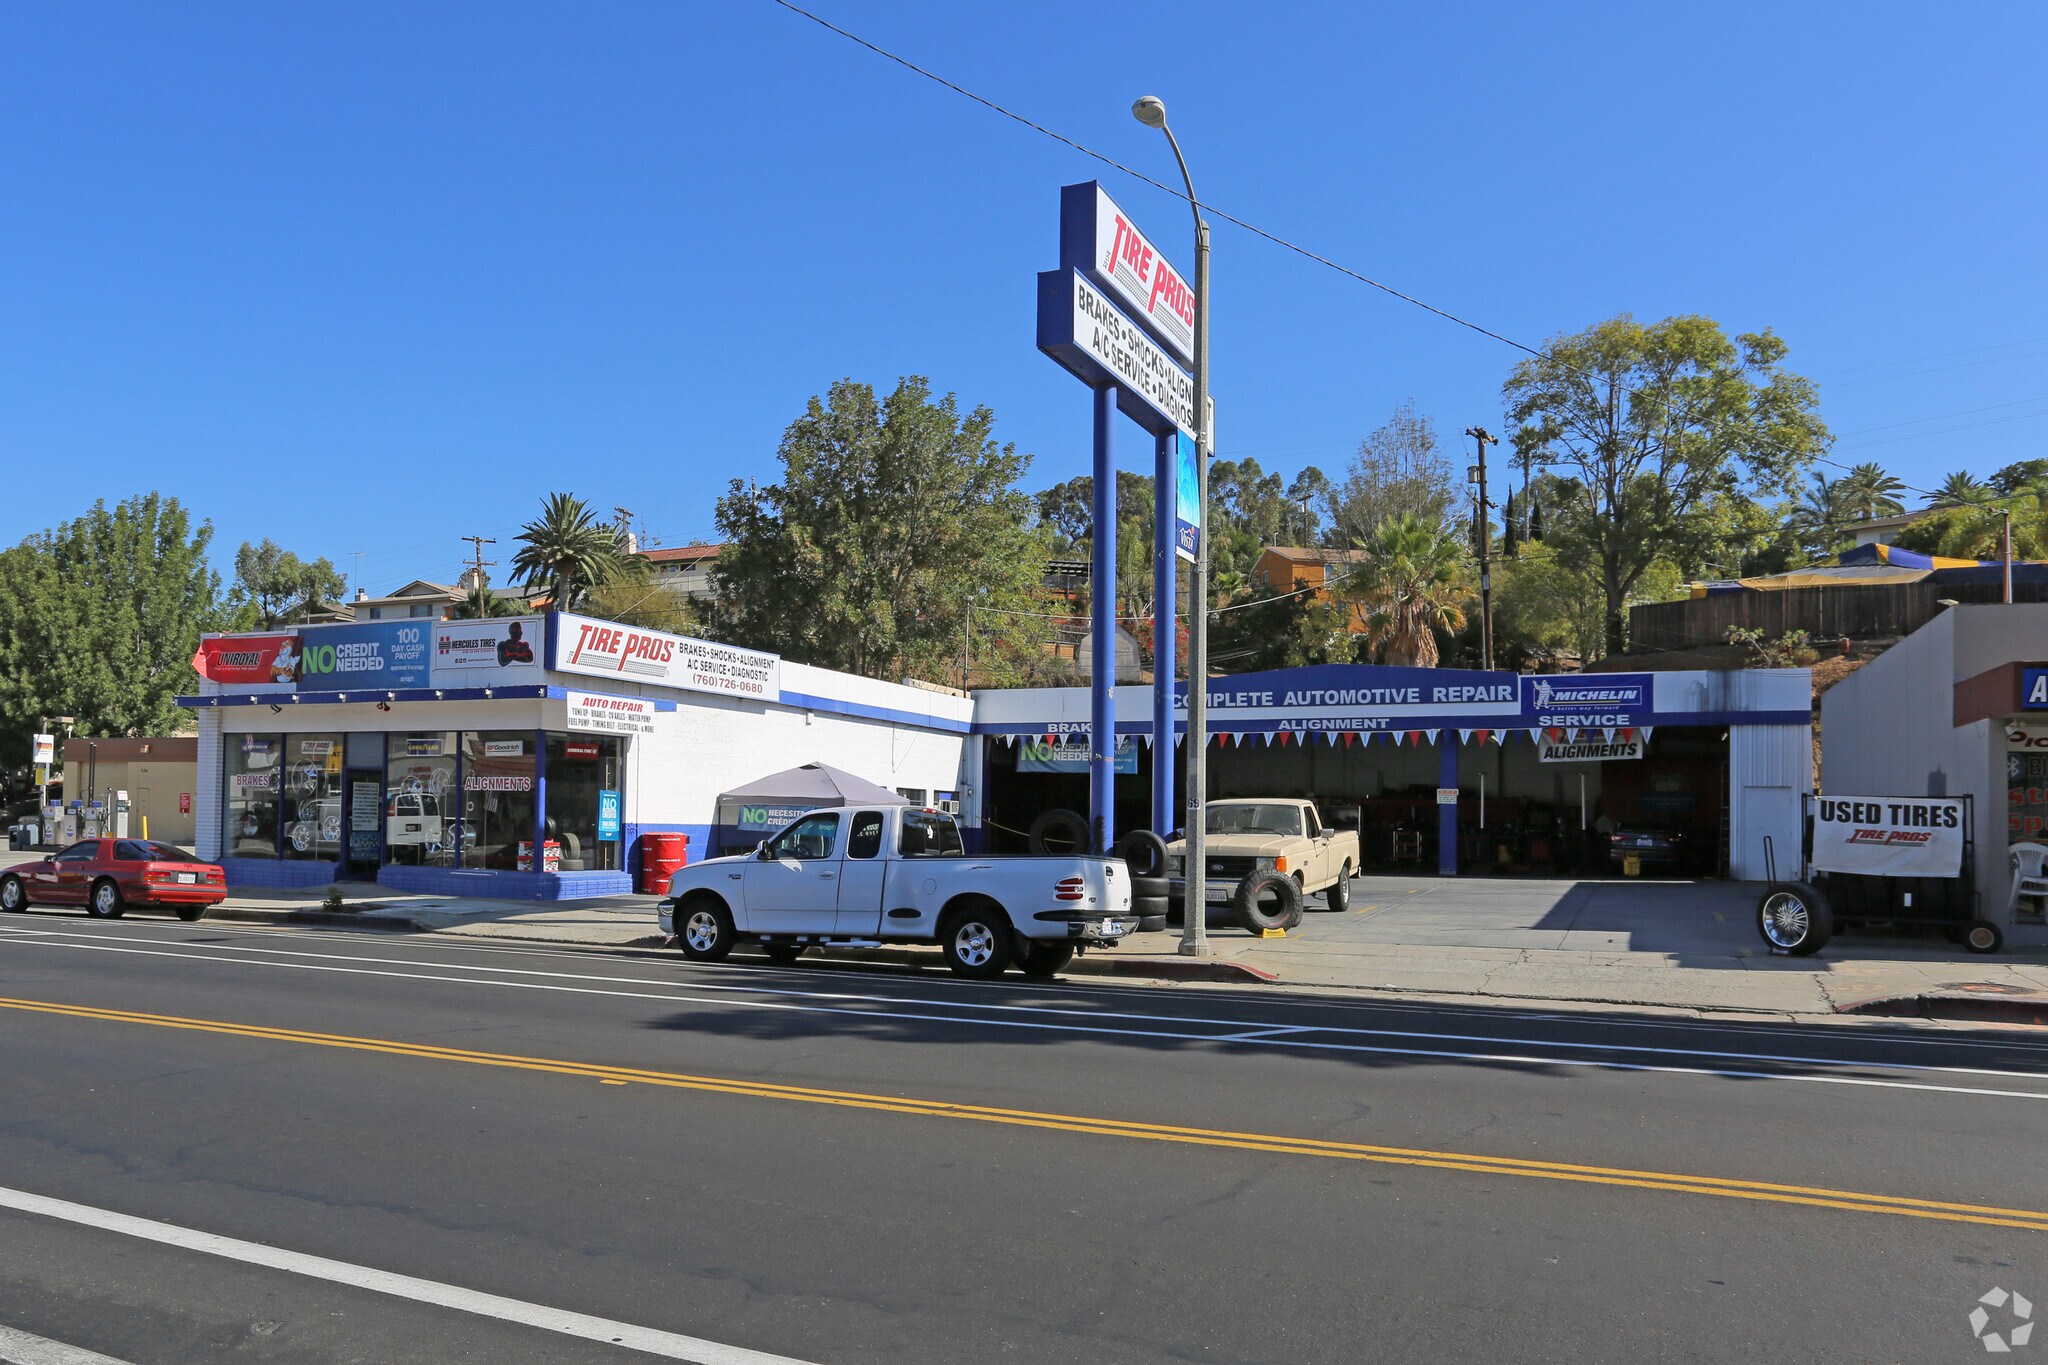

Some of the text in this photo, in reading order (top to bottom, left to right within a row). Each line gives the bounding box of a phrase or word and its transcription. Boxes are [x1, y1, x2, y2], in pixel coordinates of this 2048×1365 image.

[1108, 214, 1196, 328] TIRE PROS
[1079, 284, 1120, 341] BRAKES
[1128, 328, 1164, 378] SHOCKS
[1092, 327, 1193, 430] A/C SERVICE DIAGNOS
[397, 628, 420, 644] 100
[452, 638, 496, 648] HERCULES TIRES
[336, 643, 380, 658] CREDIT
[572, 624, 675, 671] TIRE PROS
[216, 652, 260, 666] UNIROYAL
[302, 645, 336, 674] NO
[336, 656, 384, 672] NEEDED
[679, 642, 774, 670] BRAKES SHOCKS ALIGNMENT
[687, 658, 768, 682] A/C SERVICE DIAGNOSTIC
[692, 672, 762, 693] (760) 726-0680
[1284, 688, 1420, 706] AUTOMOTIVE
[1433, 685, 1512, 702] REPAIR
[1554, 690, 1638, 700] MICHELIN
[582, 698, 644, 712] AUTO REPAIR
[583, 708, 588, 716] UP
[591, 710, 606, 718] BRAKES
[578, 718, 590, 726] PUMP
[618, 722, 638, 731] ELECTRICAL
[1048, 724, 1092, 732] BRAK
[1278, 718, 1390, 730] ALIGNMENT
[1539, 714, 1630, 726] SERVICE
[1020, 742, 1053, 761] NO
[1053, 752, 1092, 761] NEEDE
[1544, 742, 1637, 759] ALIGNMENTS
[236, 774, 269, 788] BRAKES
[464, 776, 531, 791] ALIGNMENTS
[603, 798, 617, 808] NO
[743, 808, 768, 824] NO
[1820, 800, 1958, 828] USED TIRES
[1849, 828, 1932, 846] TIRE PROS
